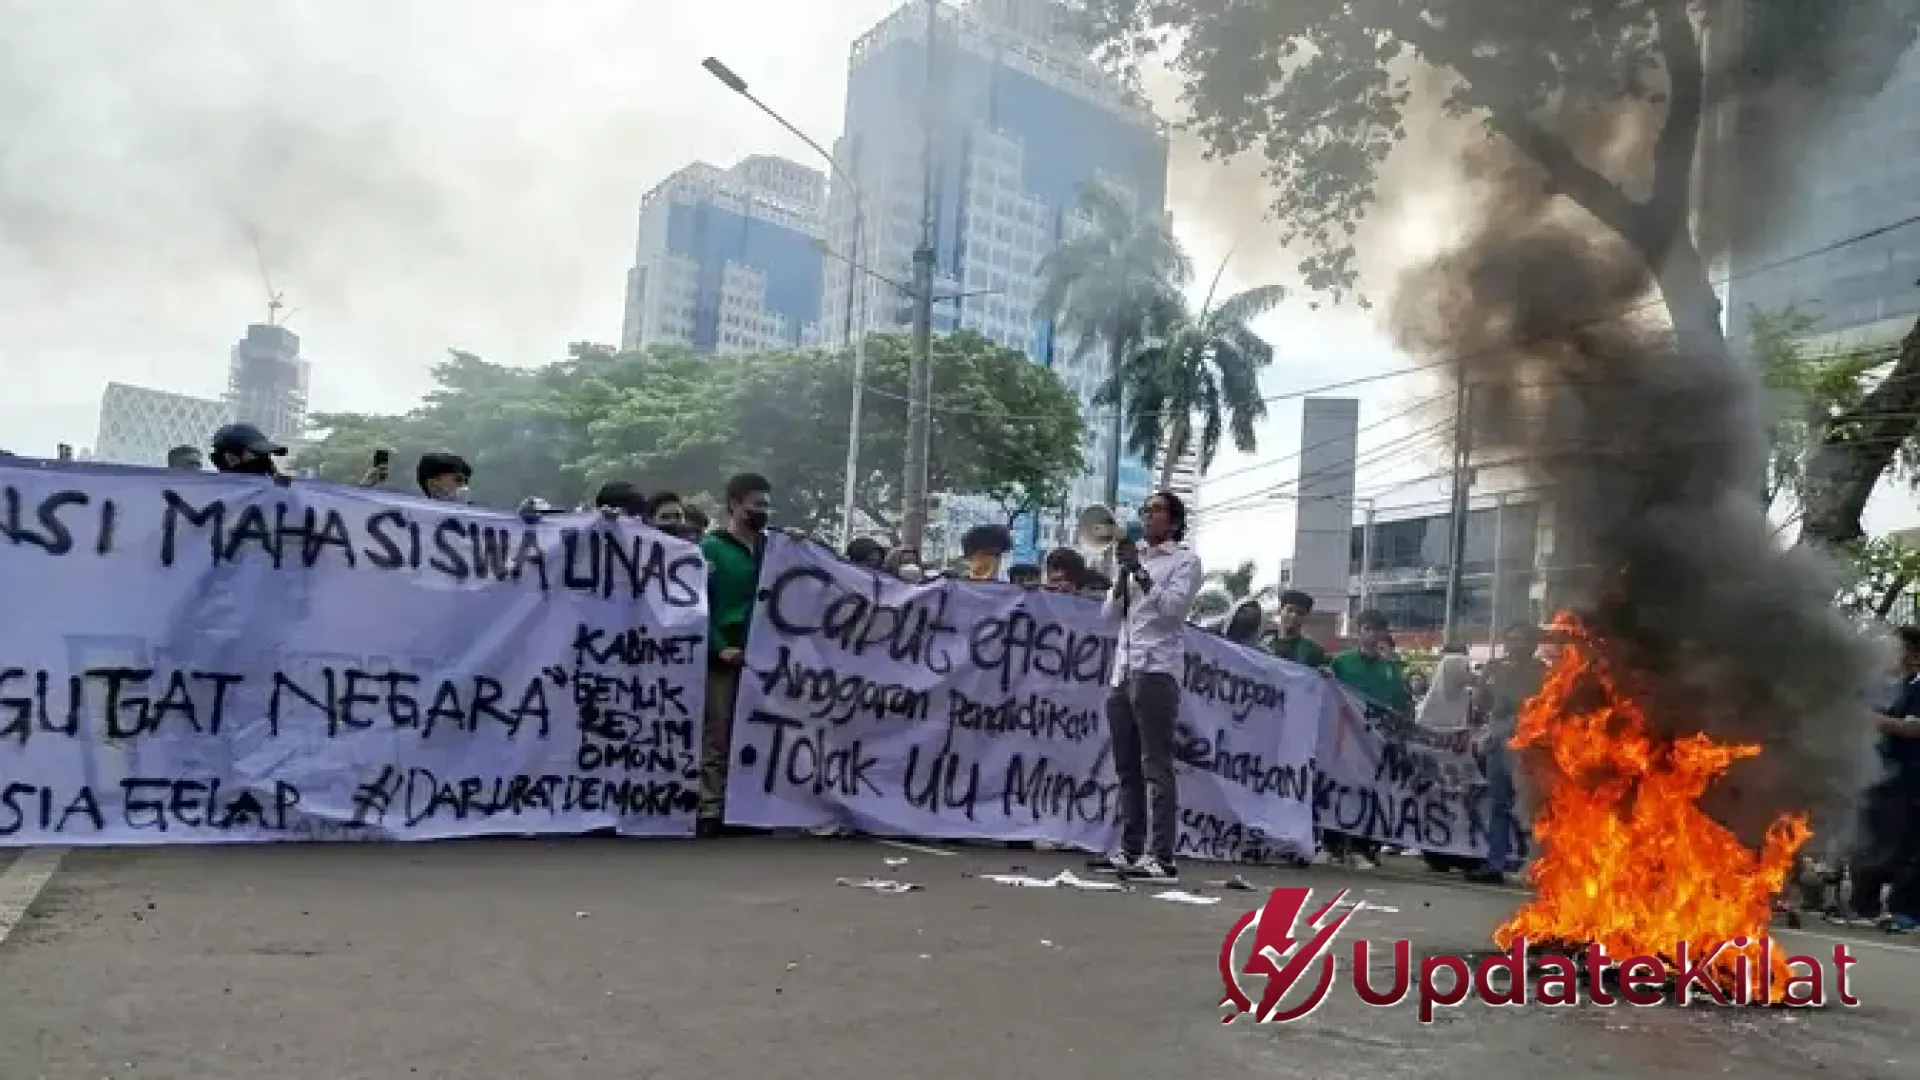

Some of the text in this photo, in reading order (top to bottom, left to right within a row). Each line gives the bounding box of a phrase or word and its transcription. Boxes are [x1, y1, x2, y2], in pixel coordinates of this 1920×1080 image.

[160, 489, 549, 598] MAHASISWA
[560, 525, 704, 606] UNAS
[120, 777, 302, 832] GELAP
[746, 709, 884, 797] Tolak
[1003, 752, 1124, 824] Miner
